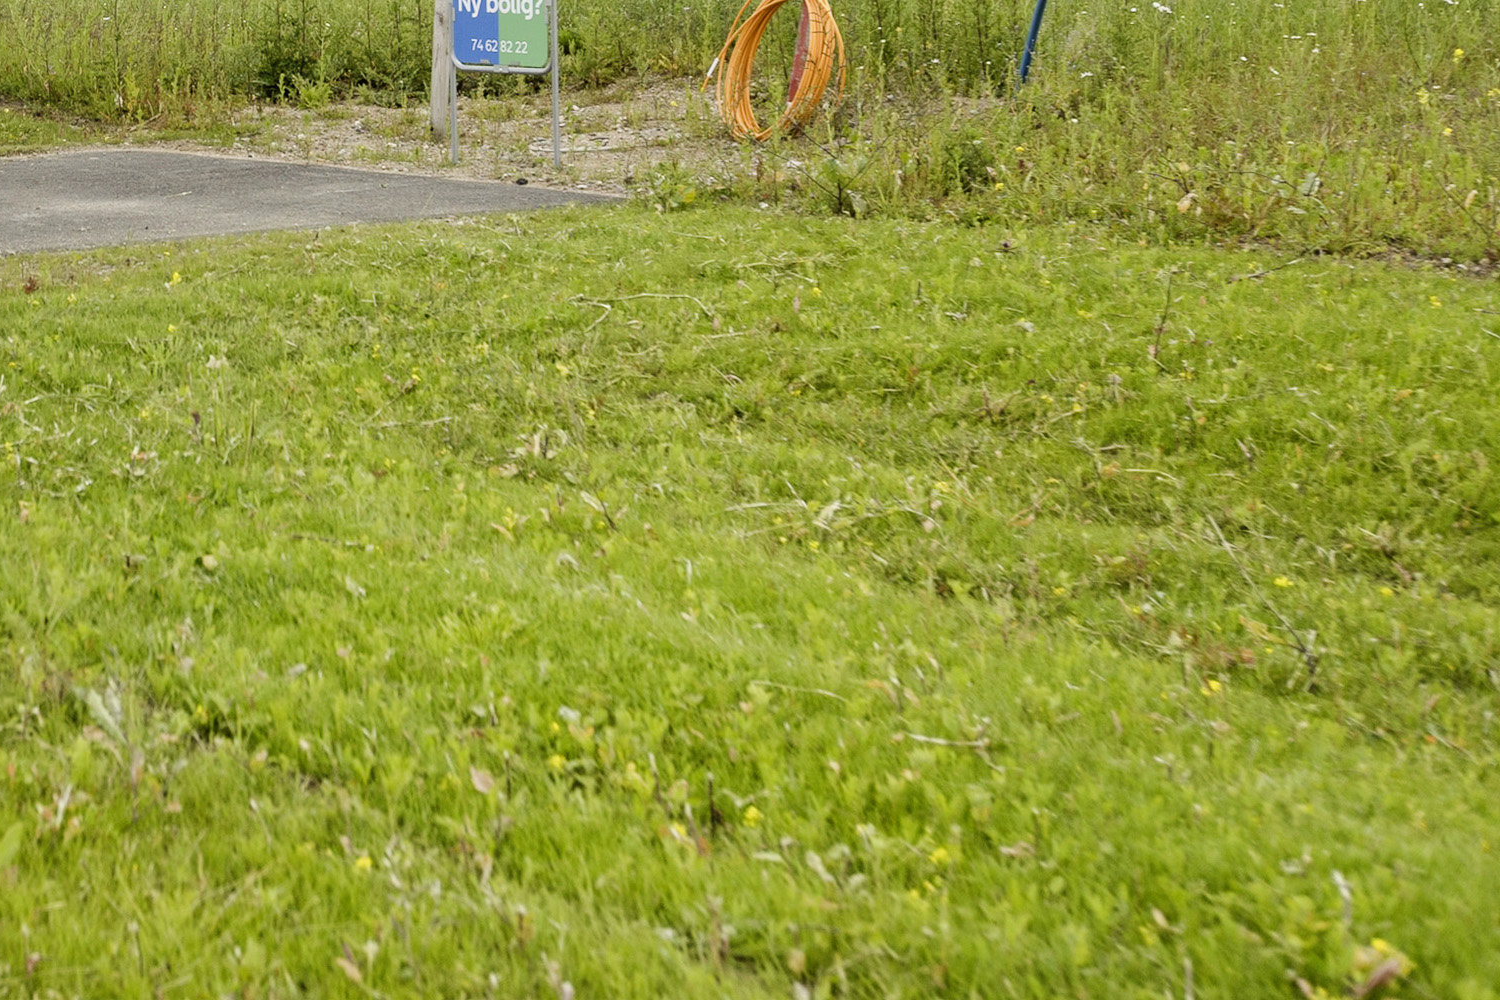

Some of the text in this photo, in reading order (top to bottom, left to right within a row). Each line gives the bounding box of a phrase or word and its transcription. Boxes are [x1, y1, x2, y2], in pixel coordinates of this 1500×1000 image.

[471, 38, 528, 54] 74 62 82 22
